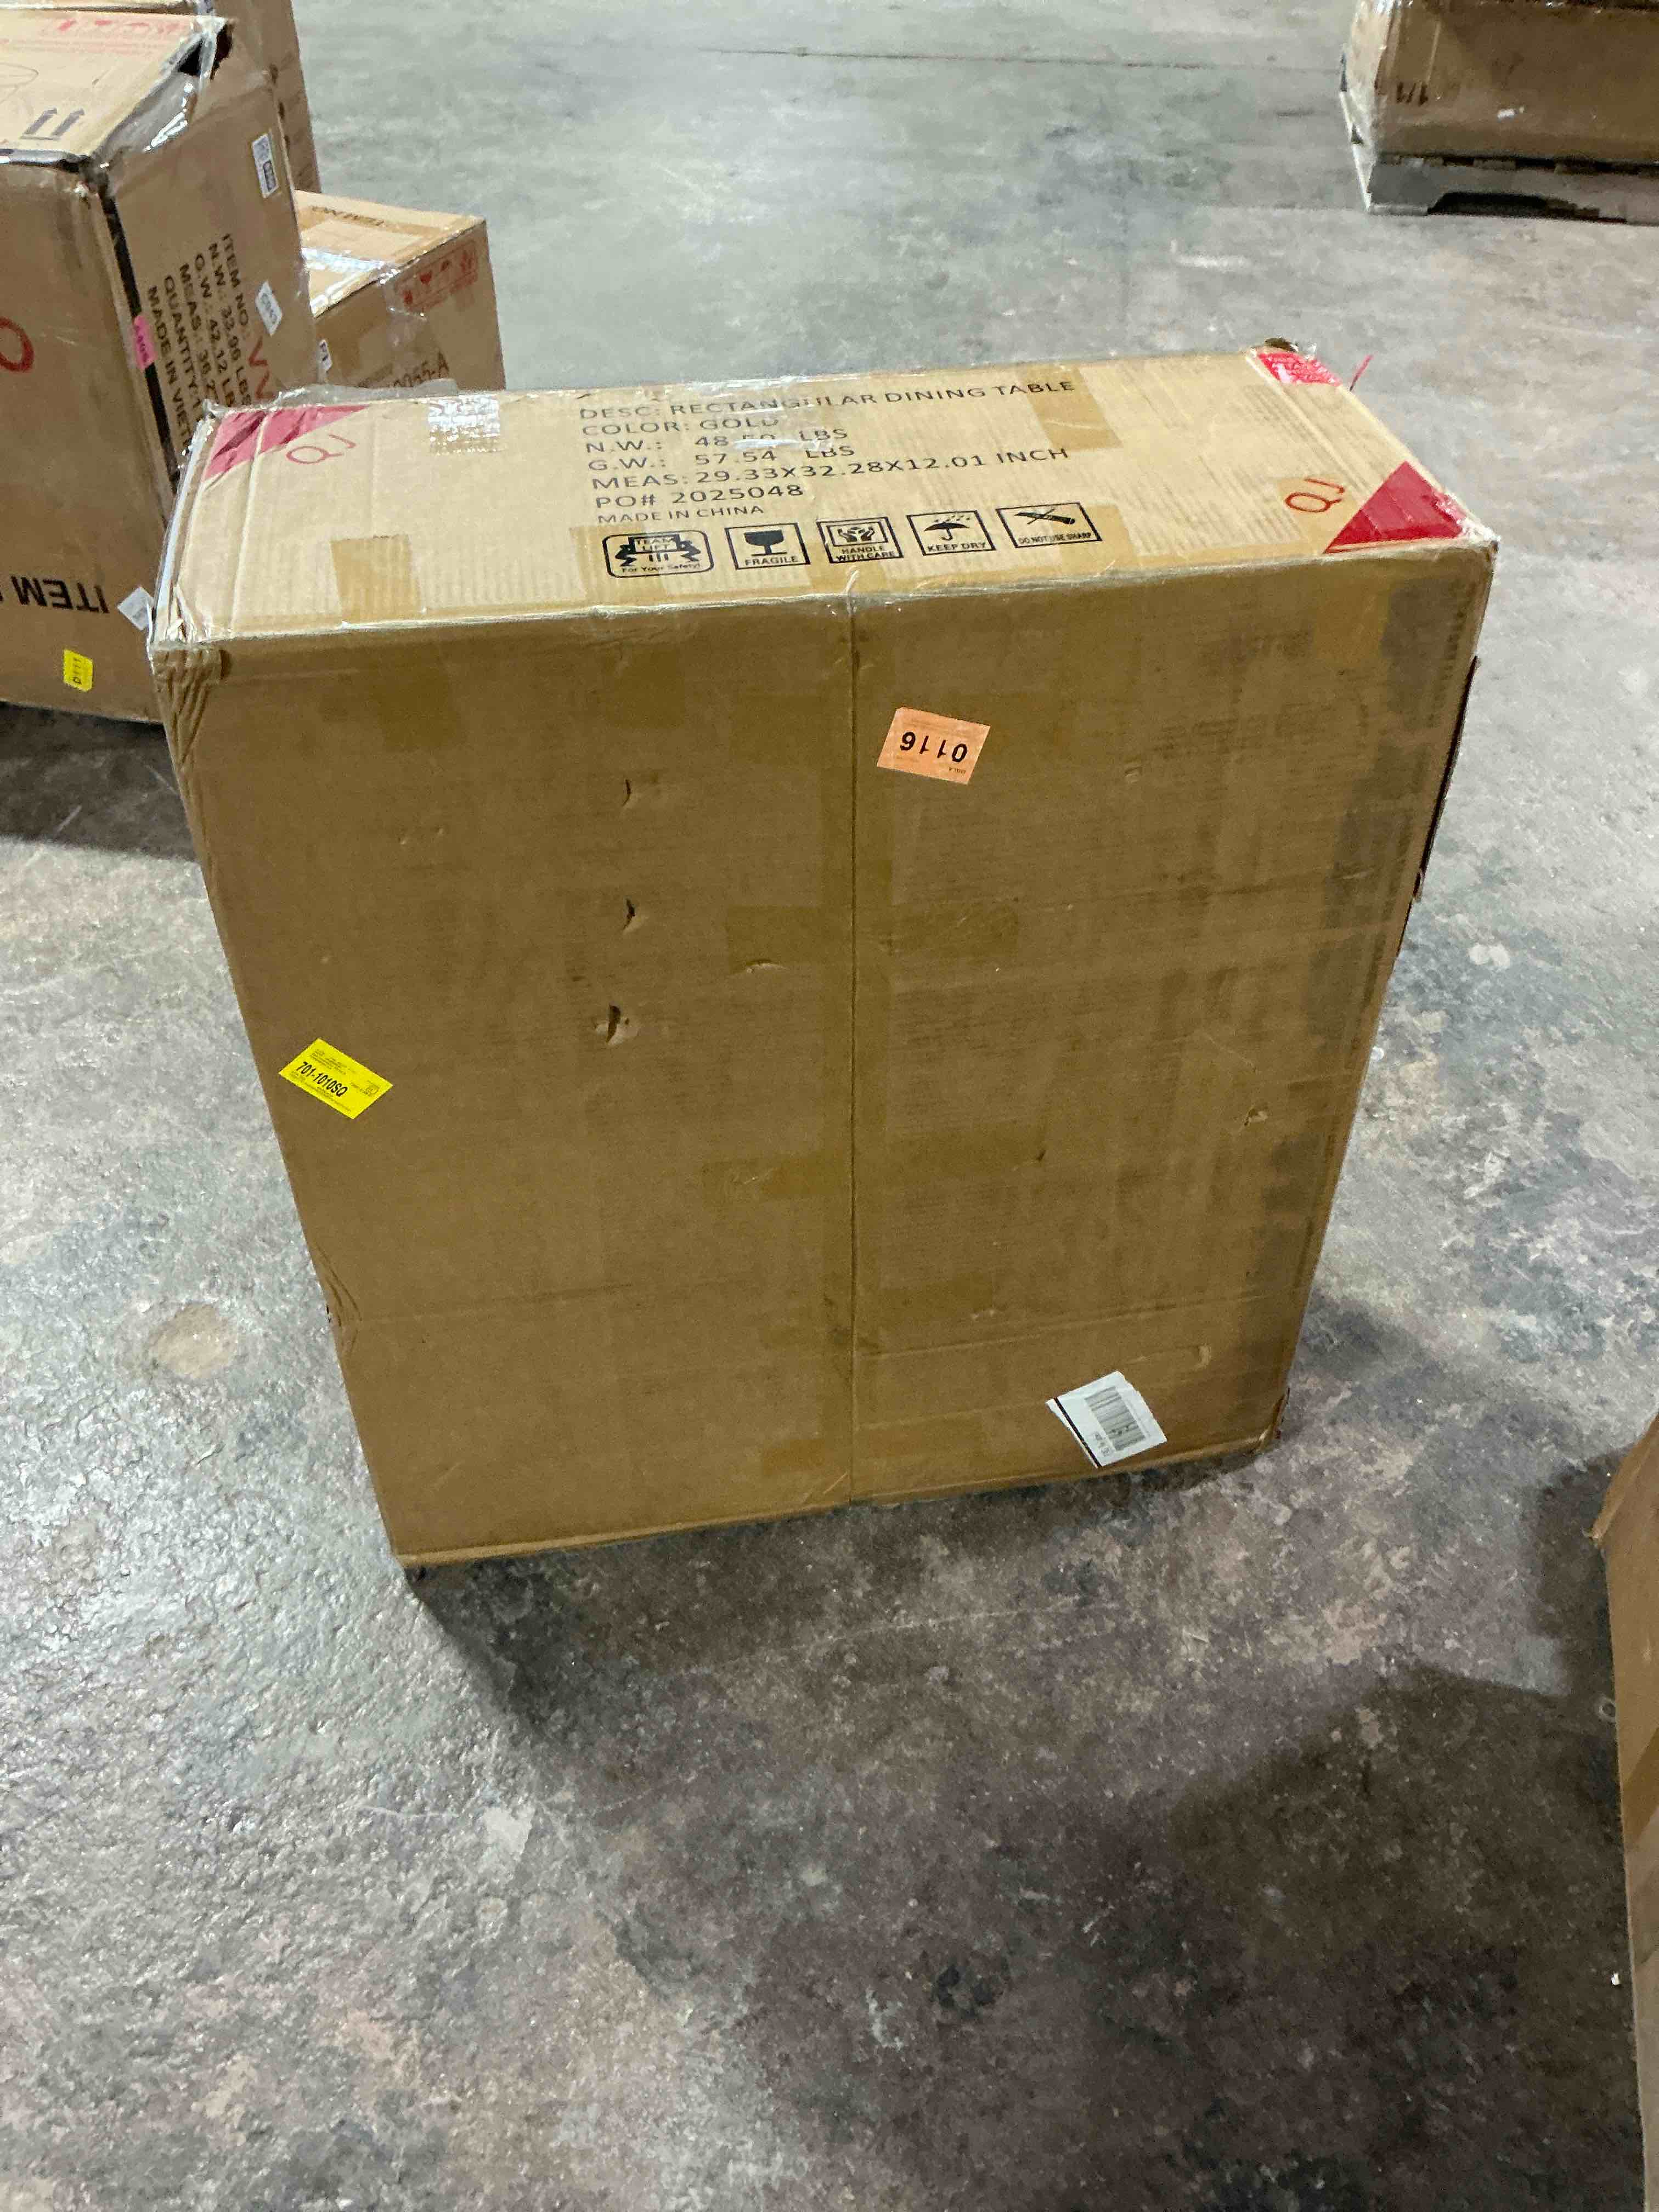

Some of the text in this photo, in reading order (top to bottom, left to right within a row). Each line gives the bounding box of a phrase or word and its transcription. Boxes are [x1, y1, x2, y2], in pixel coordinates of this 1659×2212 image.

[223, 233, 241, 289] ITEM
[148, 286, 171, 355] MADE
[165, 360, 177, 385] IN
[885, 387, 986, 403] DINING
[991, 381, 1076, 397] TABLE
[583, 417, 779, 436] COLOR: GOLD
[799, 428, 848, 442] LBS
[588, 445, 855, 471] G.W.: 57.54 LBS
[592, 474, 689, 490] MEAS:
[996, 448, 1069, 464] INCH
[596, 484, 805, 509] PO# 2025048
[598, 505, 765, 524] MADE IN CHINA
[842, 545, 883, 554] HANDLE
[867, 550, 895, 558] CARE
[927, 541, 986, 552] KEEP DRY
[744, 555, 799, 566] FRAGILE
[10, 575, 110, 613] ITEM
[900, 731, 968, 763] 0116
